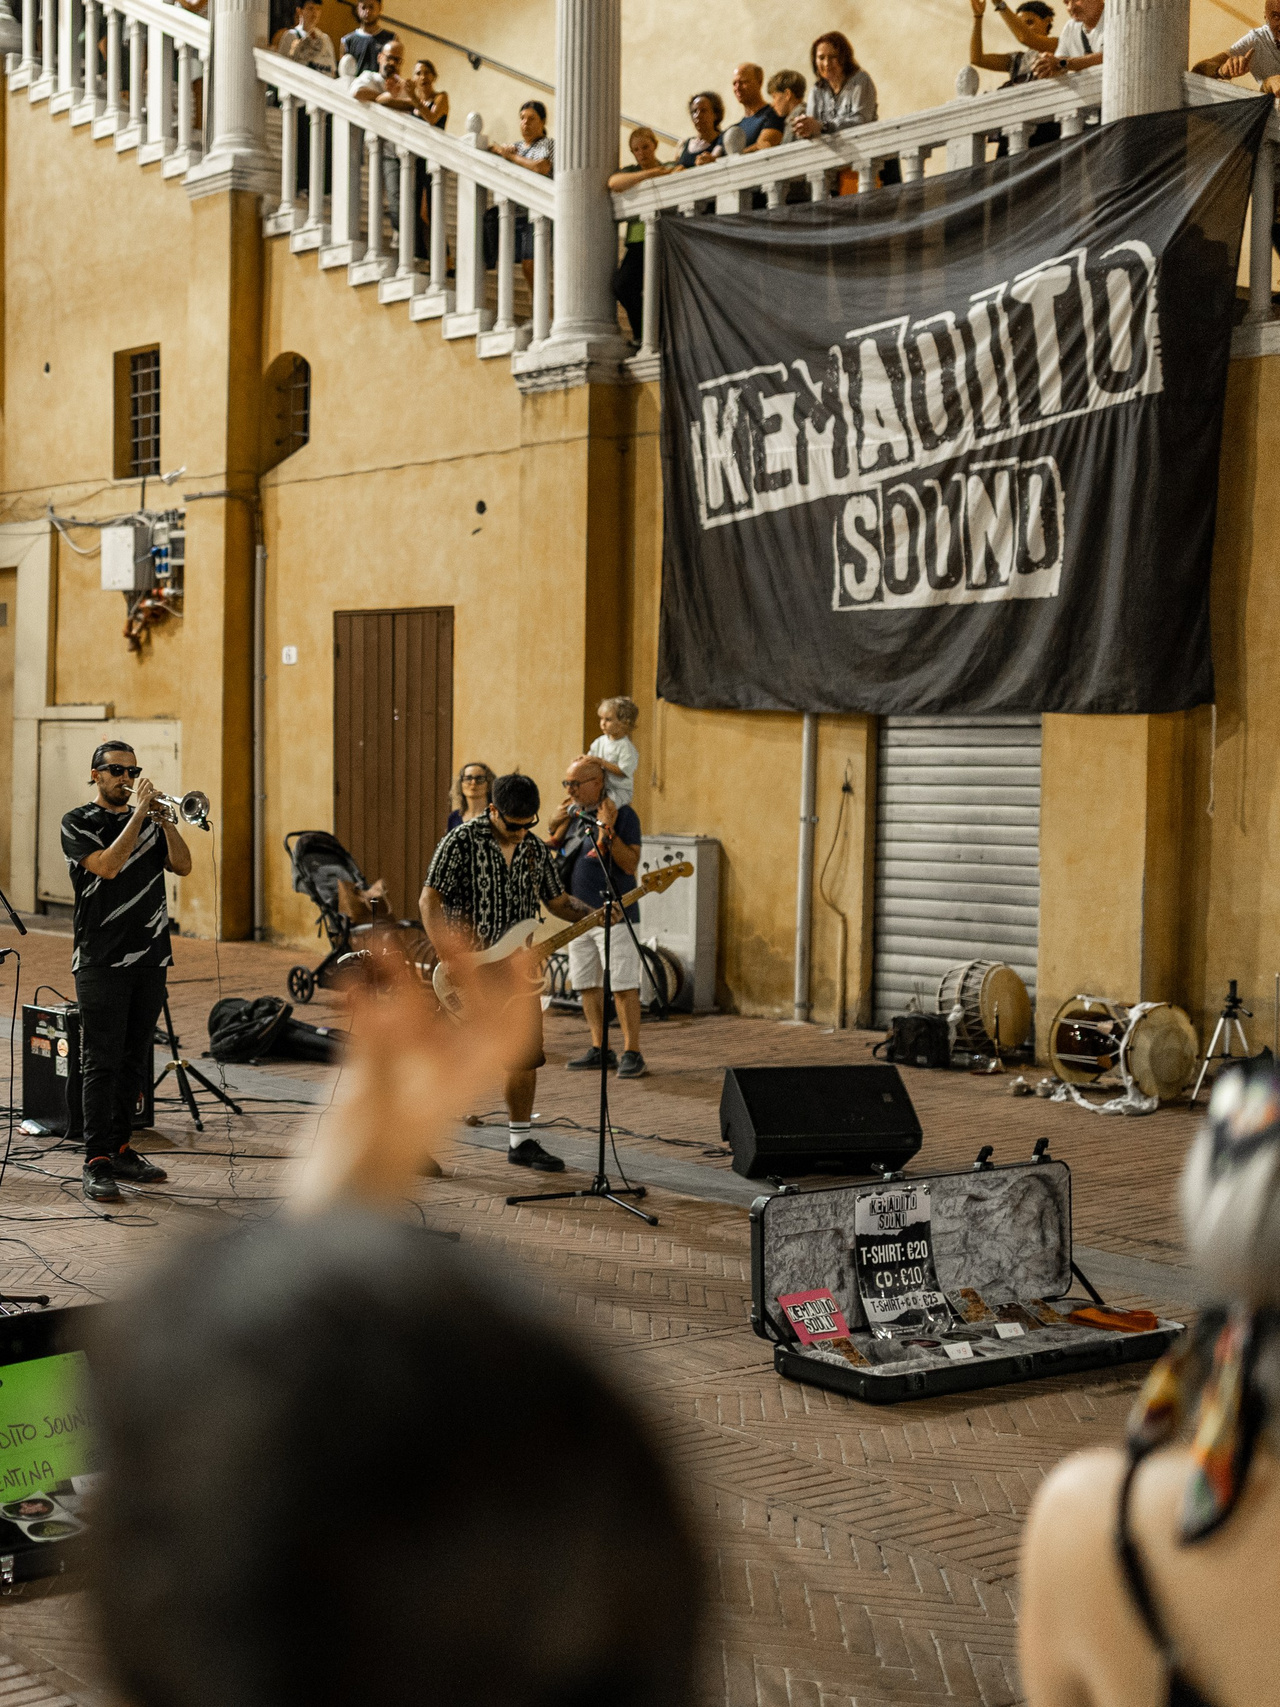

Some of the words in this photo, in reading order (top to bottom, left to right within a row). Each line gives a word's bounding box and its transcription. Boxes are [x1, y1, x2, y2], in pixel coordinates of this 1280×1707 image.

[834, 456, 1063, 610] SOUND
[878, 1212, 909, 1230] SOUND
[860, 1243, 906, 1265] T-SHIRT:
[906, 1240, 928, 1260] €20
[804, 1314, 838, 1334] SOUND
[44, 1406, 91, 1438] SOUN
